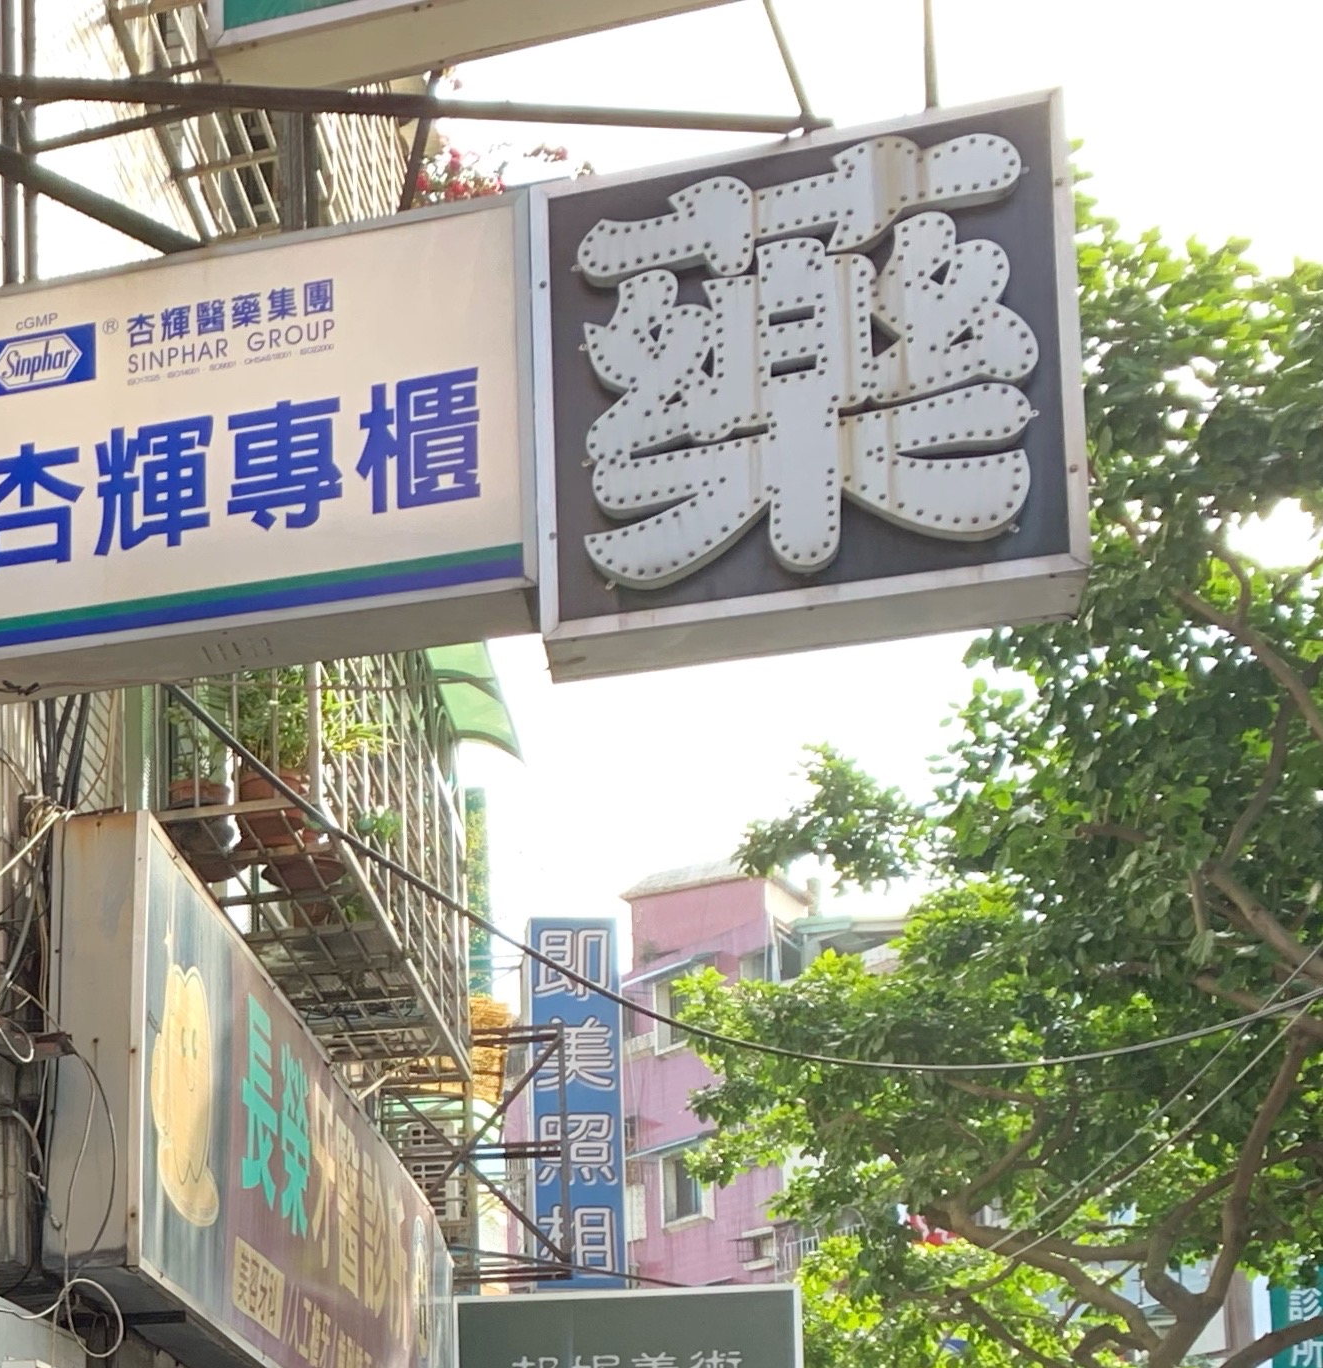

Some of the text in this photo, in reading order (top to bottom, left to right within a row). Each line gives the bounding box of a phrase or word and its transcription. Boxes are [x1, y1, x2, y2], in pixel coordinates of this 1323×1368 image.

[15, 312, 59, 331] cGMP
[126, 278, 335, 348] 杏輝醫藥集團
[0, 341, 73, 382] Sinphar
[127, 319, 335, 375] SINPHAR GROUP
[577, 133, 1042, 591] 藥
[534, 928, 618, 1280] 即美照相
